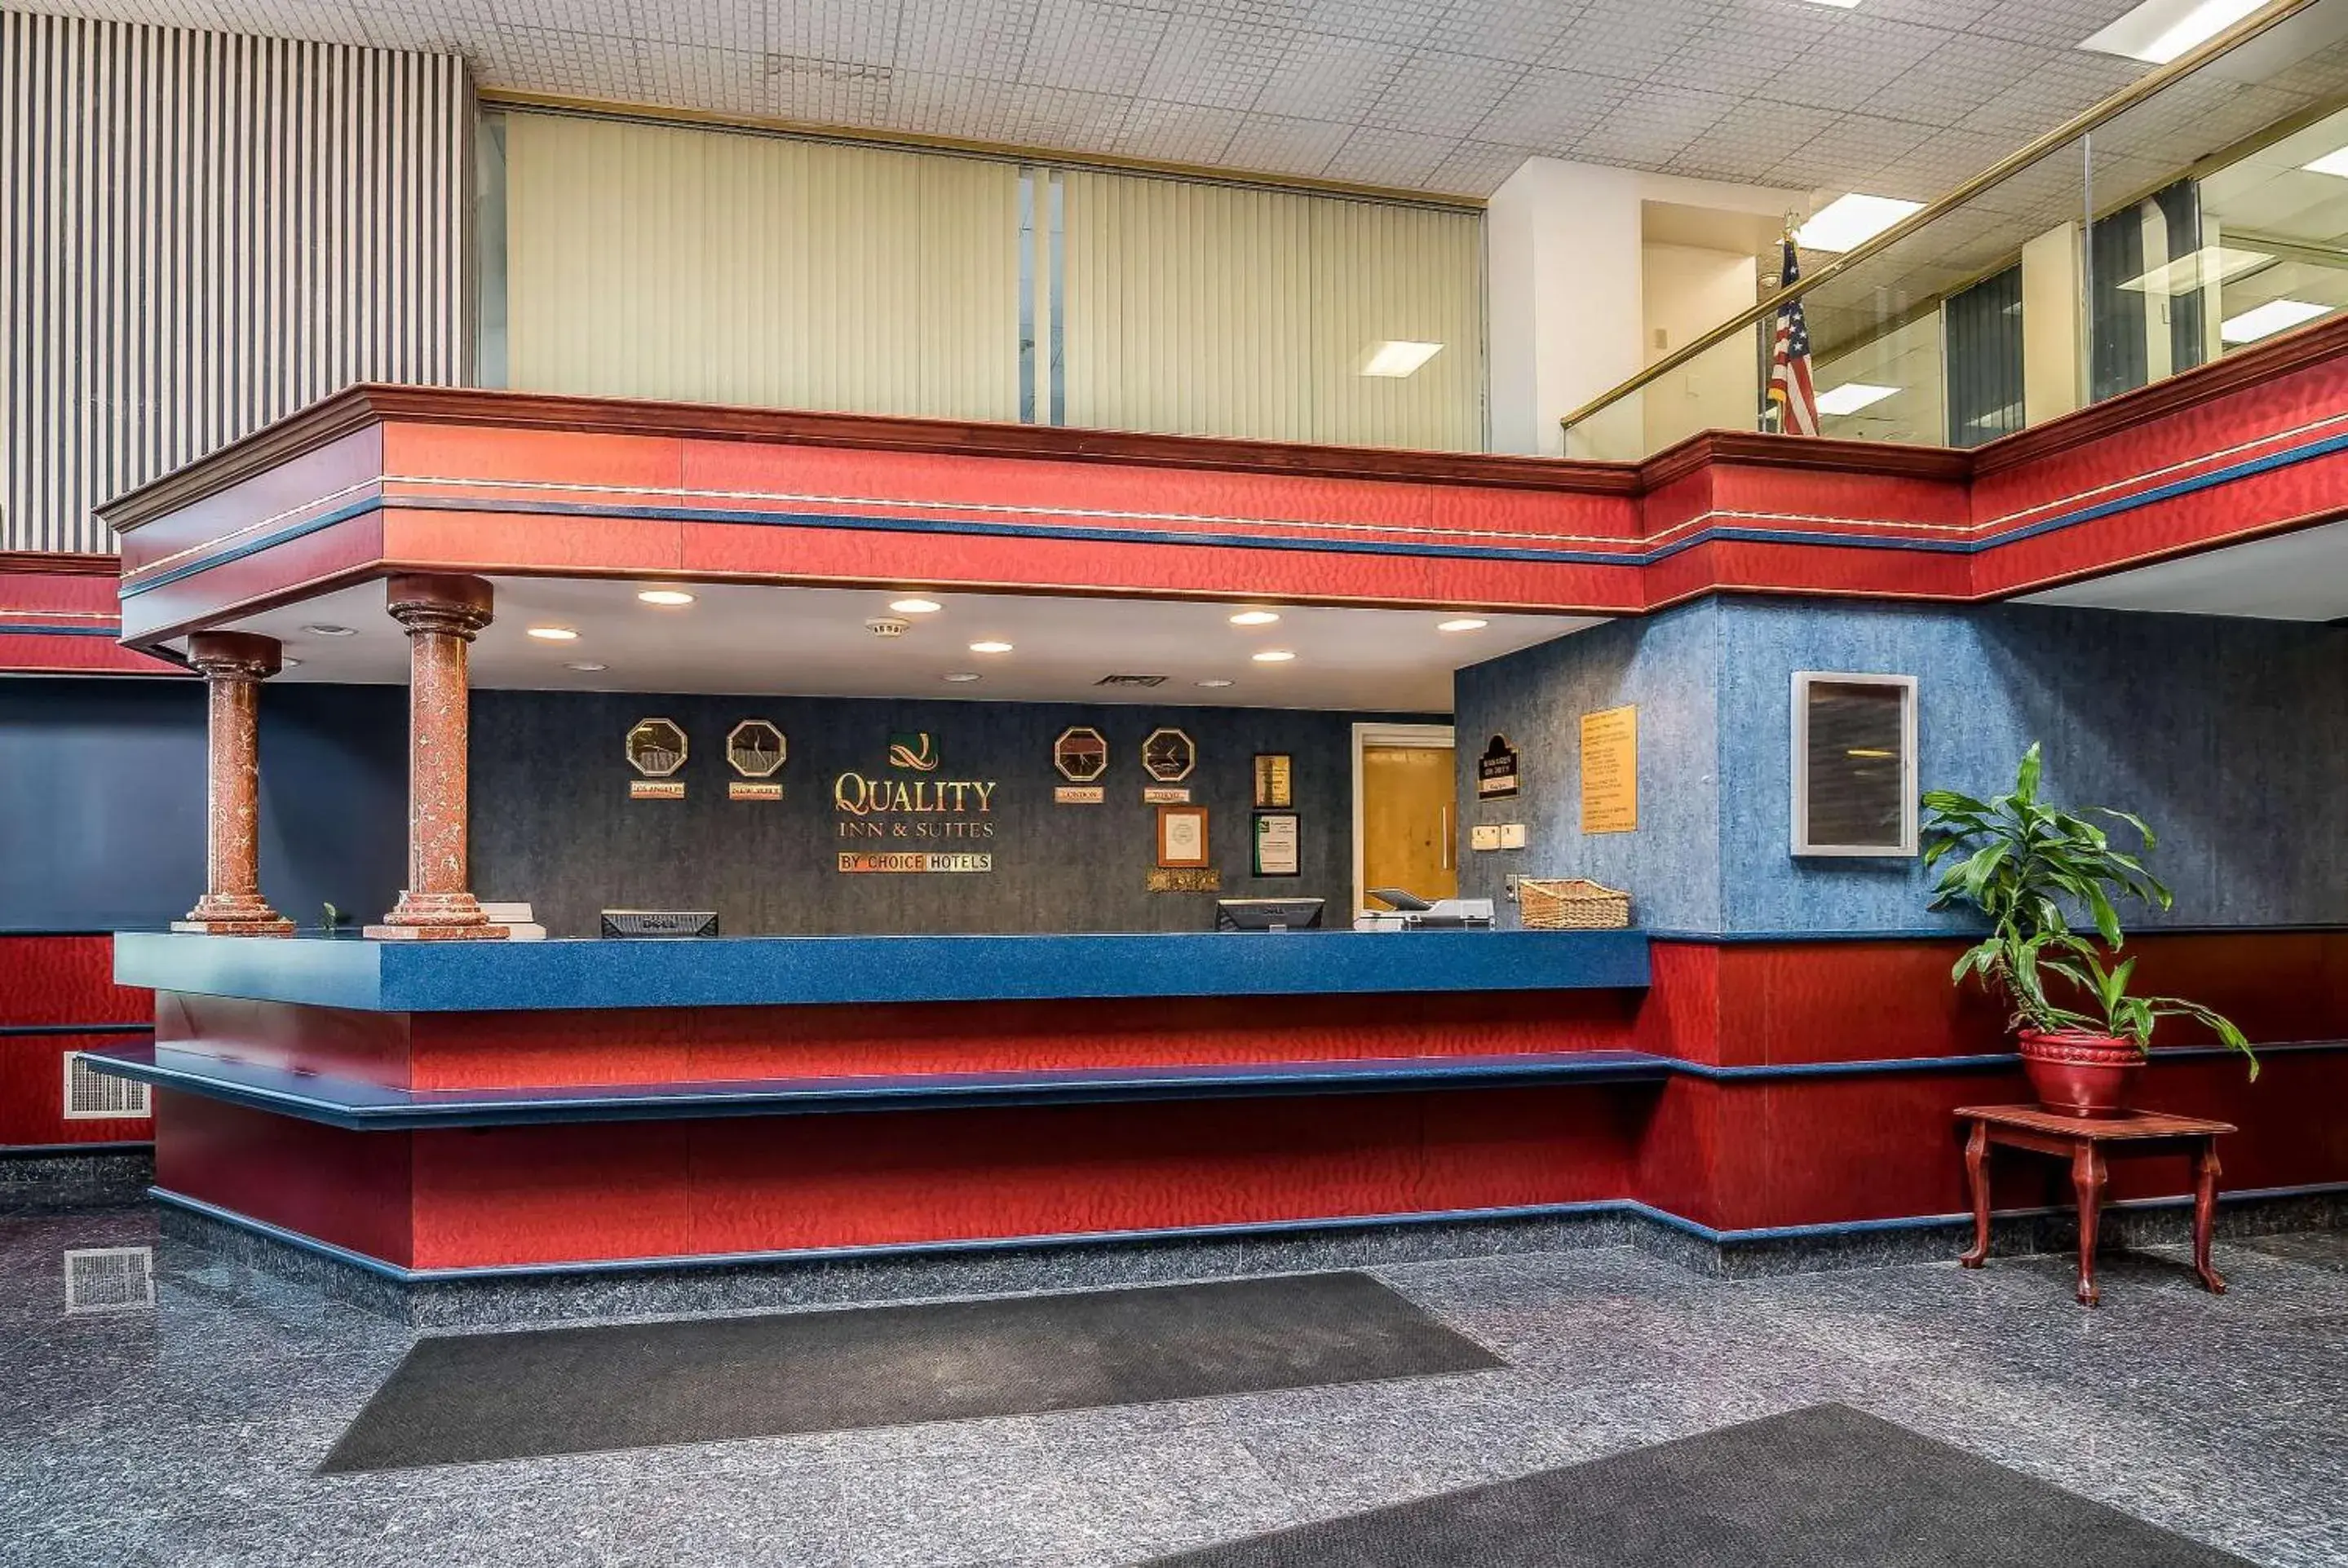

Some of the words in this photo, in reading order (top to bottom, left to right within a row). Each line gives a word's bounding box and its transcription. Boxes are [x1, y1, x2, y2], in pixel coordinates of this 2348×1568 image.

[834, 772, 997, 816] QUALITY
[839, 822, 884, 837] INN
[892, 822, 908, 837] &
[916, 822, 994, 838] SUITES
[841, 855, 862, 869] BY
[867, 855, 922, 869] CHOICE
[930, 855, 989, 869] HOTELS
